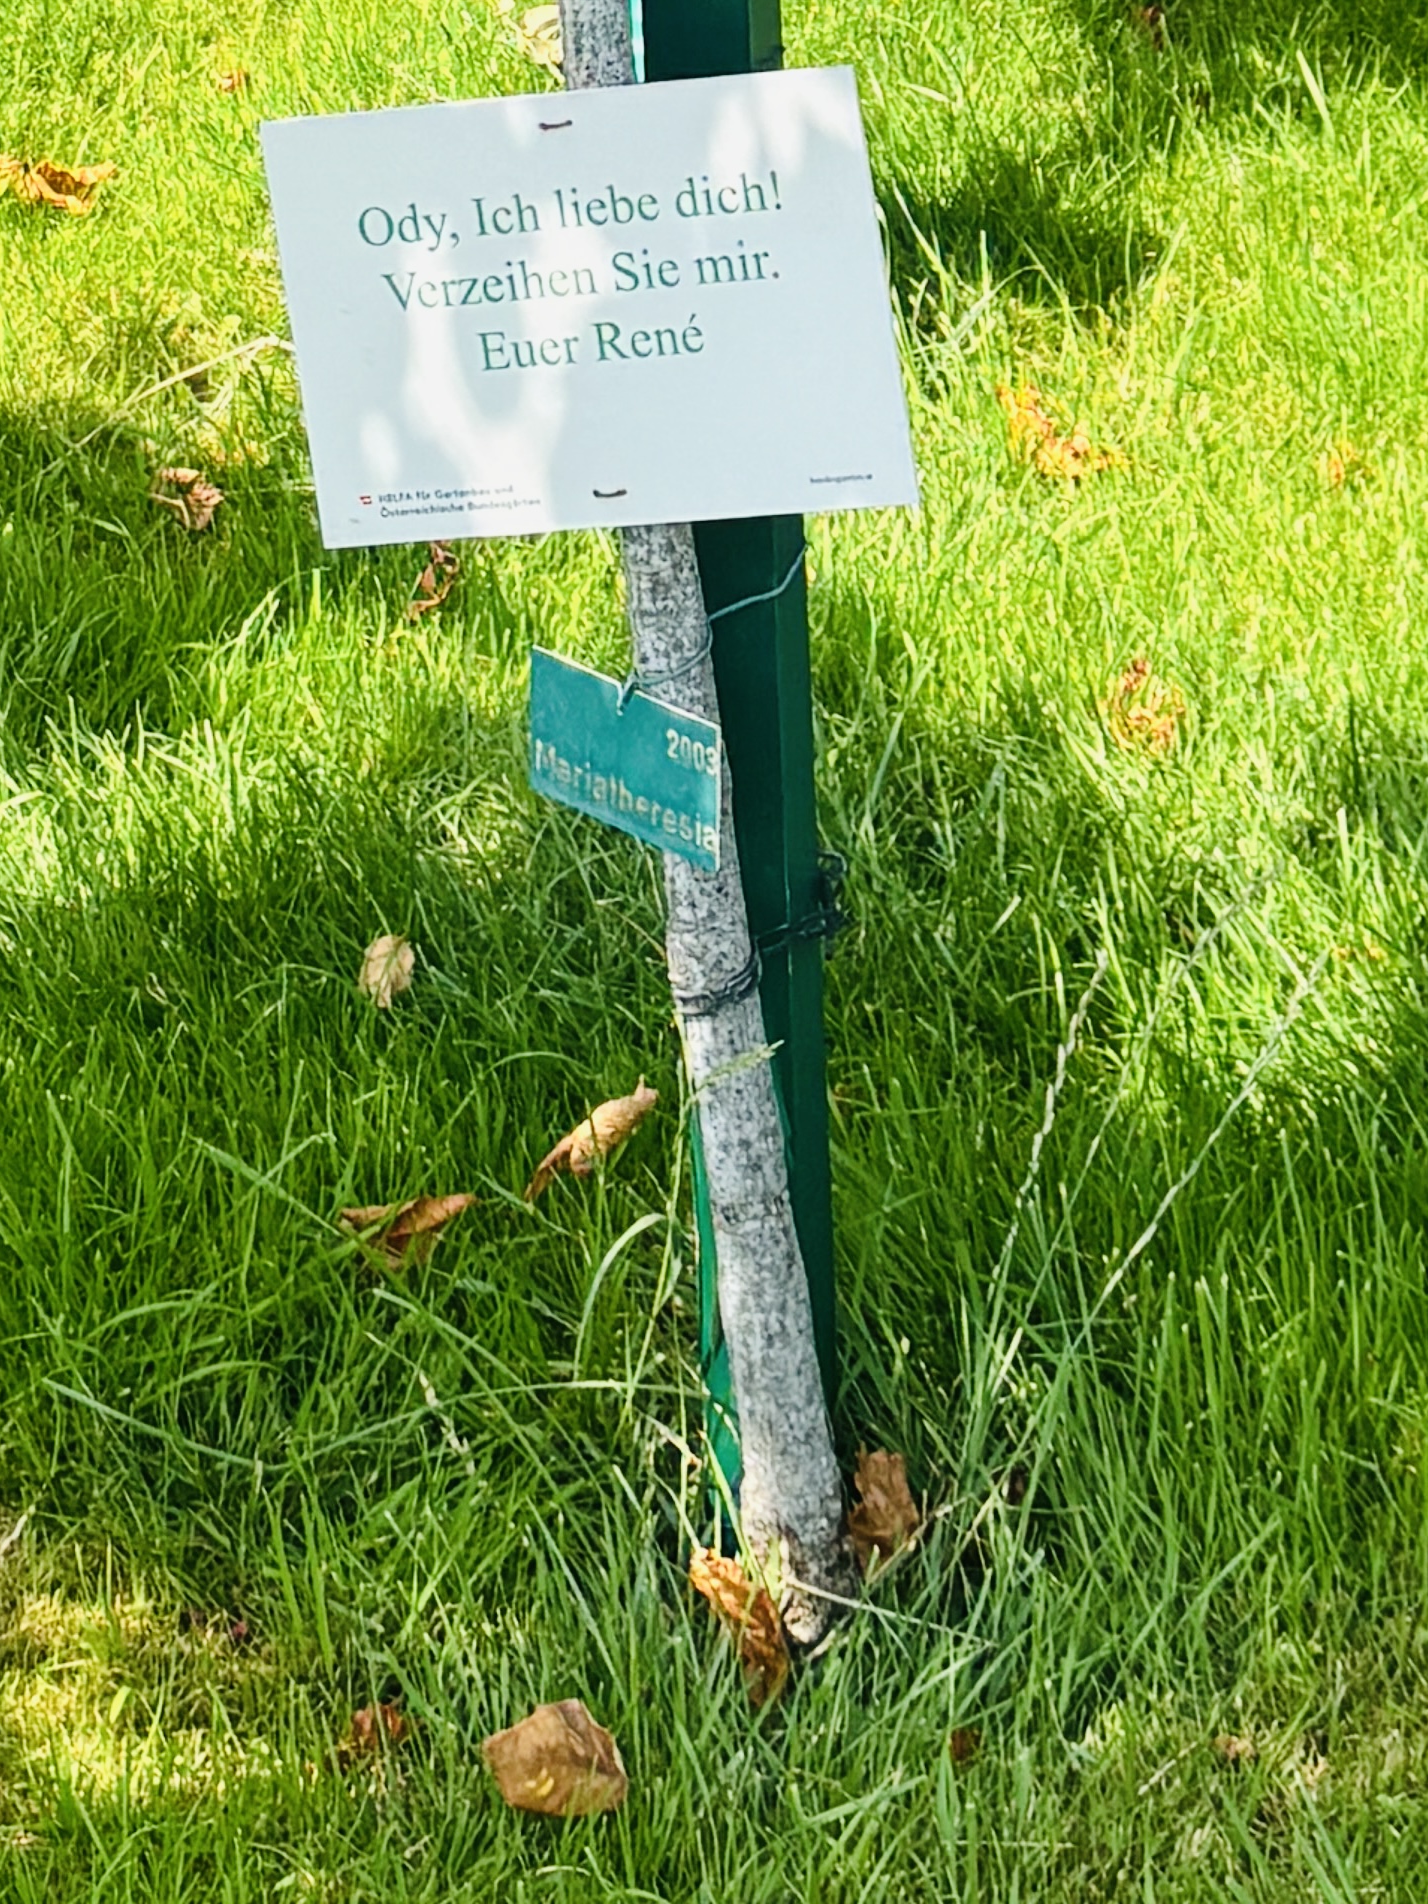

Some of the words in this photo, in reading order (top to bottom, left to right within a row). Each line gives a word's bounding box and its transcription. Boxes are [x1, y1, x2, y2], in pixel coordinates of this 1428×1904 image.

[357, 204, 461, 252] Ody,
[473, 193, 541, 237] Ich
[554, 183, 661, 230] liebe
[675, 170, 783, 219] dich!
[380, 259, 598, 313] Verzeihen
[611, 249, 681, 293] Sie
[695, 240, 780, 285] mir.
[477, 328, 578, 373] Euer
[592, 314, 706, 364] René
[666, 728, 719, 777] 2003
